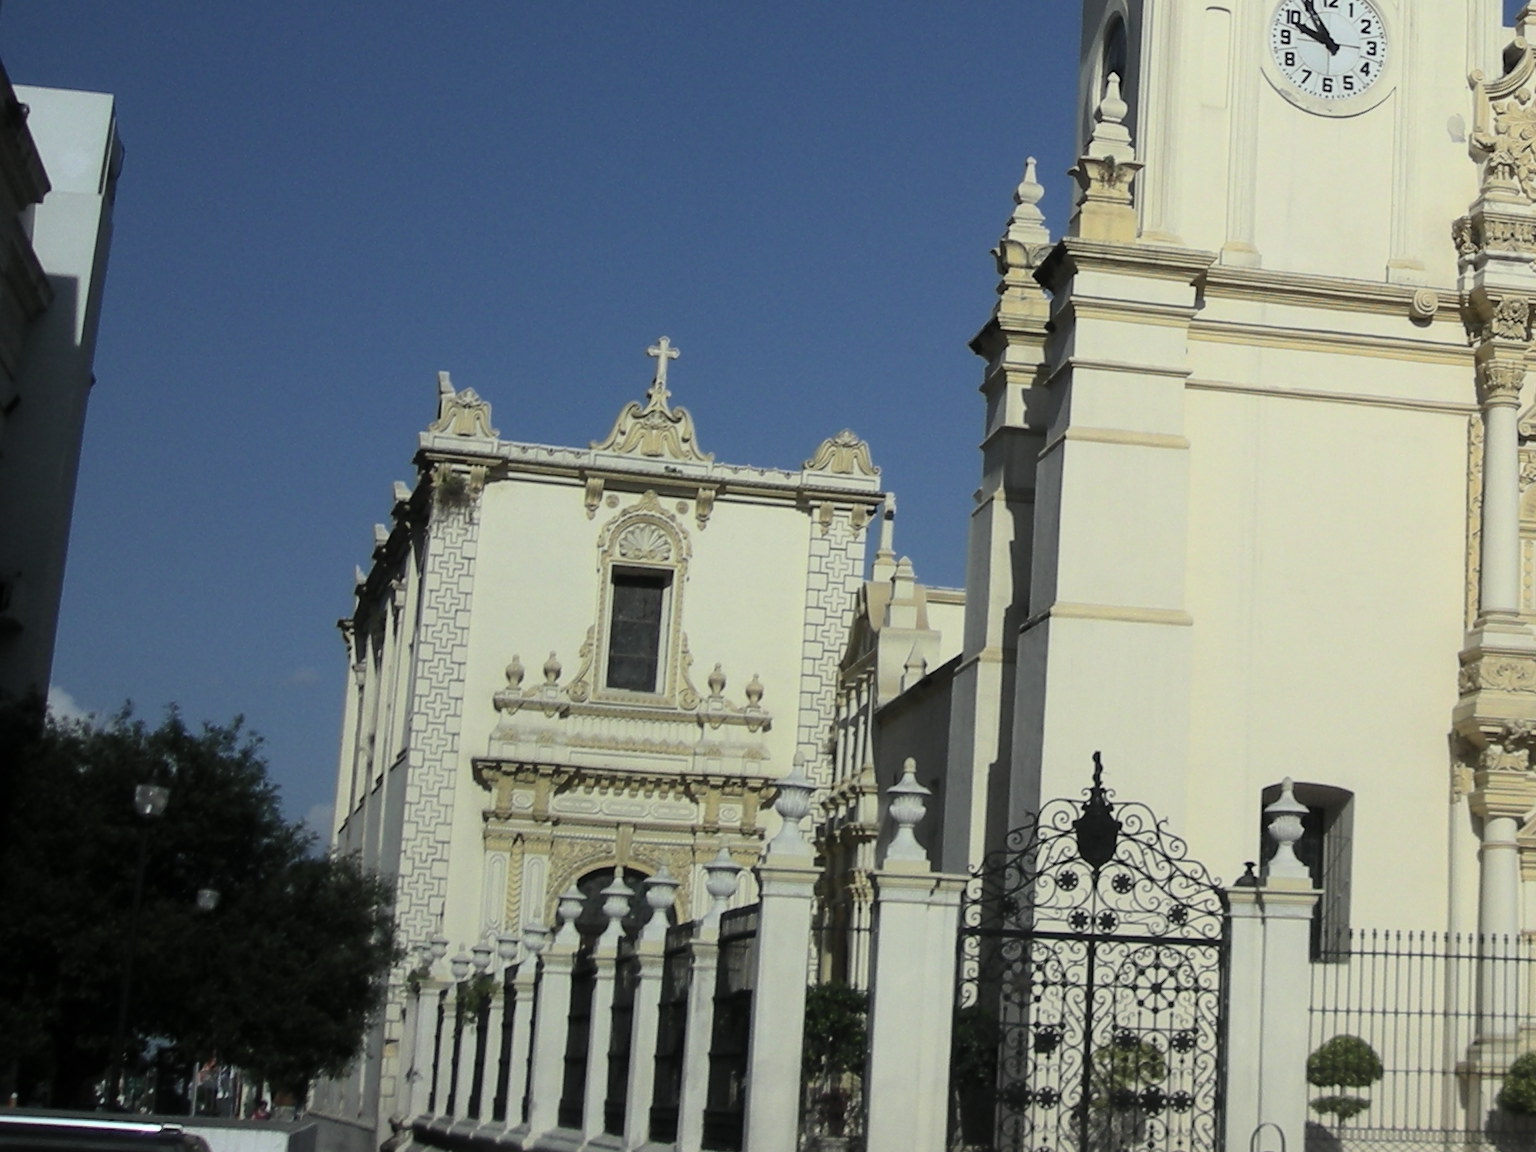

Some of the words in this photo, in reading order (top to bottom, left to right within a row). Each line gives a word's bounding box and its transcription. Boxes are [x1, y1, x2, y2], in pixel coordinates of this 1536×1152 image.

[1286, 9, 1301, 25] 10
[1349, 3, 1354, 18] 1
[1360, 19, 1371, 34] 2
[1280, 29, 1291, 45] 9
[1366, 41, 1377, 56] 3
[1284, 52, 1295, 67] 8
[1302, 69, 1312, 84] 7
[1360, 62, 1371, 77] 4
[1322, 77, 1333, 93] 6
[1343, 75, 1354, 90] 5
